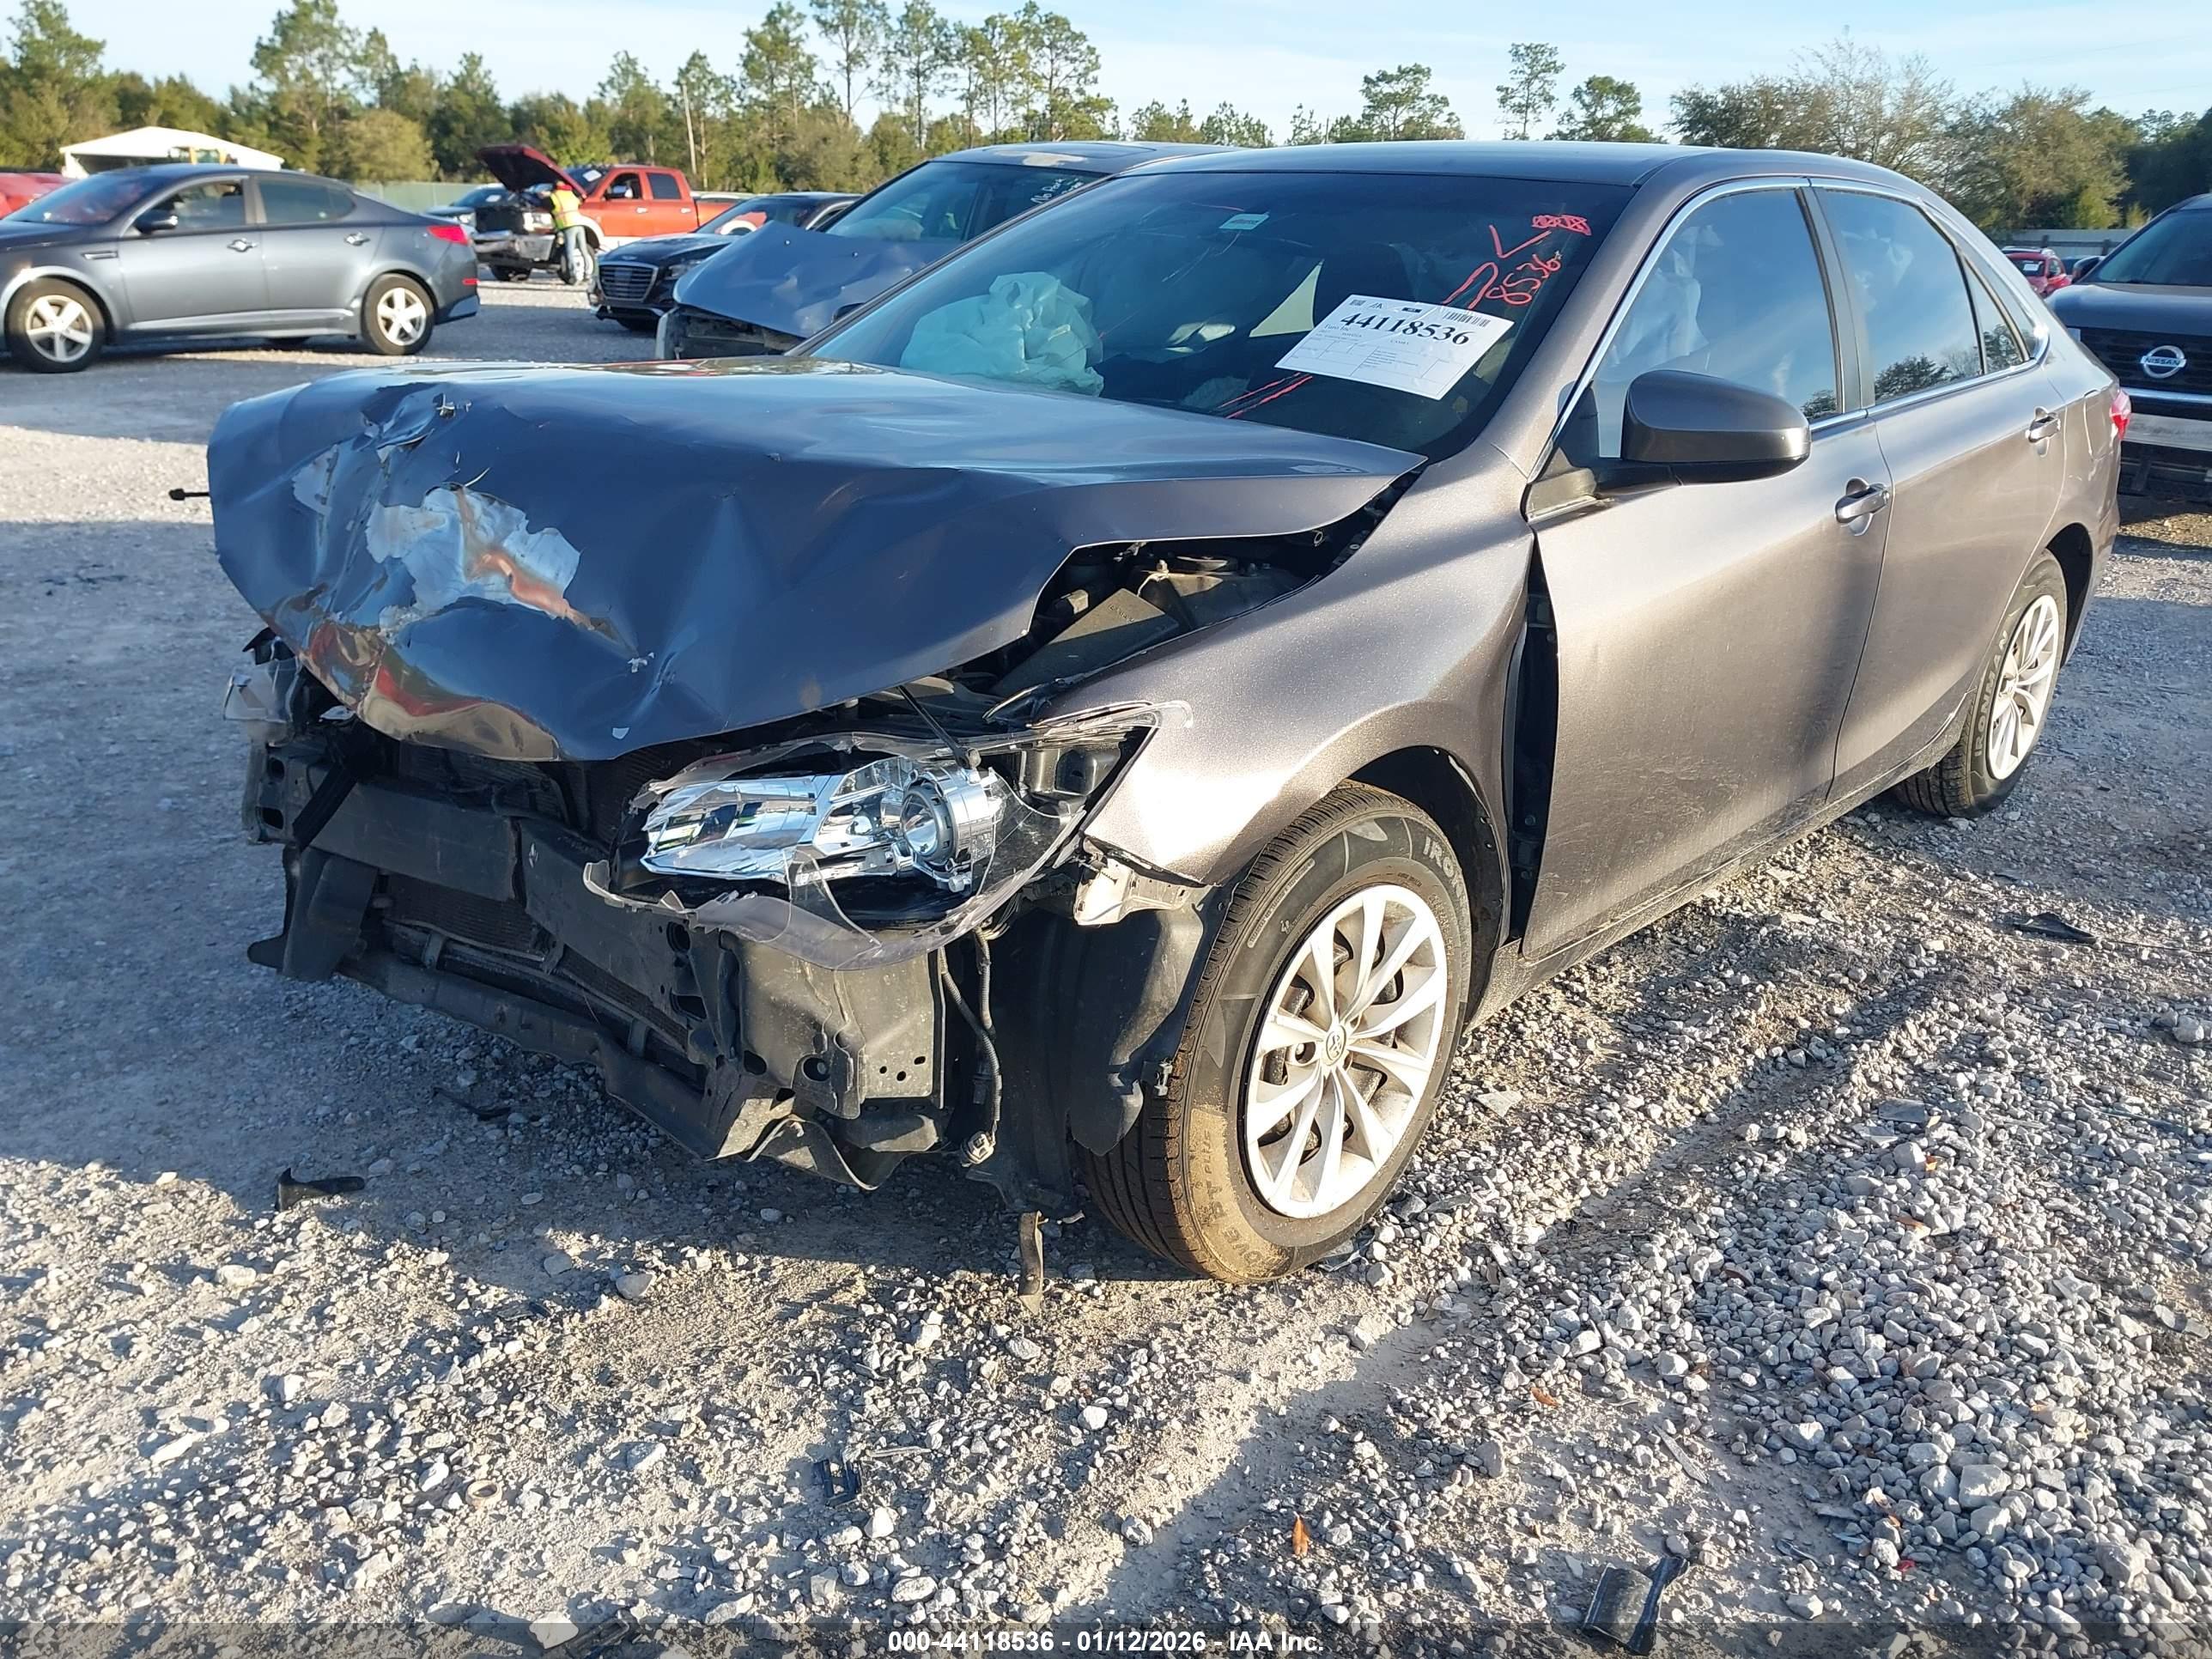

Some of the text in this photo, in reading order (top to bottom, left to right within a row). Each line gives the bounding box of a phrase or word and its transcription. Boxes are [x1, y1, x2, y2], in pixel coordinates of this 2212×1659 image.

[1340, 313, 1476, 346] 44118536
[2144, 357, 2181, 367] NISSAN
[1974, 630, 2008, 757] IRONMAN
